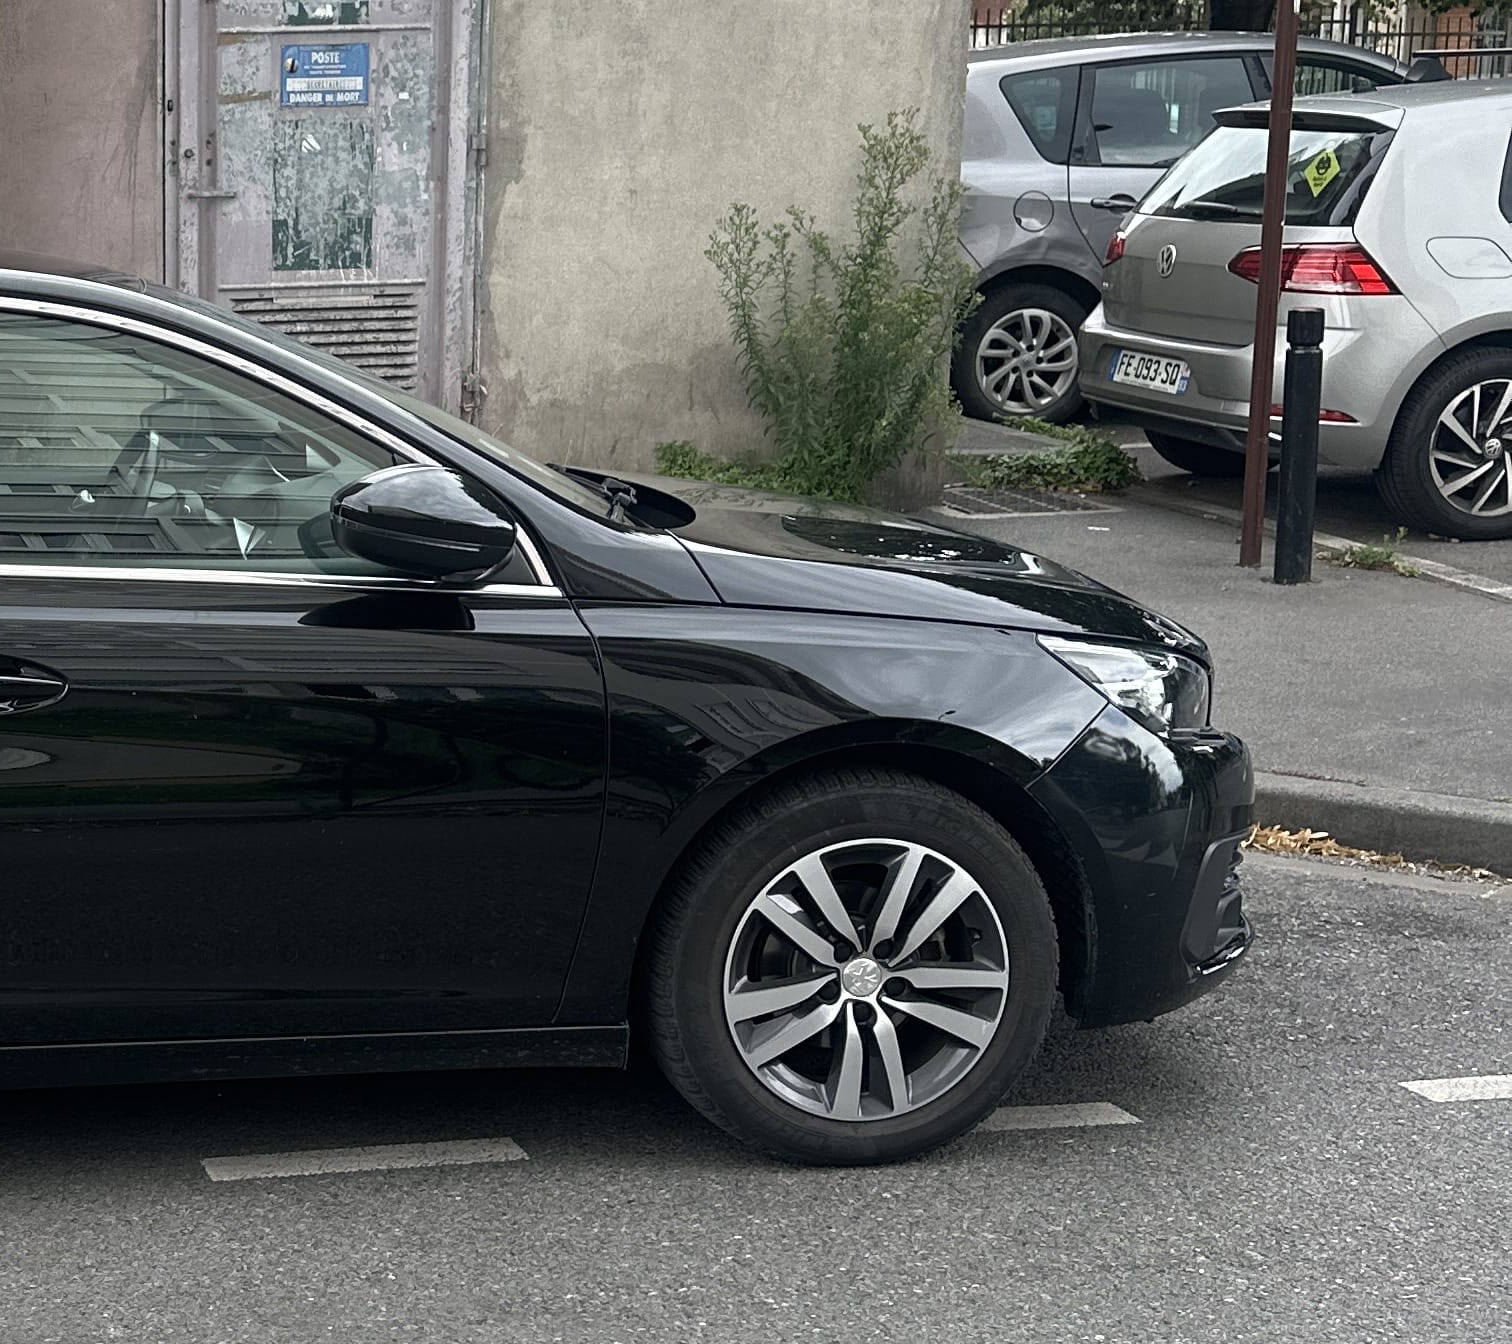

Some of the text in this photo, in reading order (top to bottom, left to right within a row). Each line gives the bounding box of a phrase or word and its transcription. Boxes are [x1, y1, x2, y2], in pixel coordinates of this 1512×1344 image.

[311, 51, 340, 64] POSTE
[289, 92, 323, 103] DANGER
[336, 91, 360, 102] MORT
[1117, 353, 1181, 386] FE-093-SQ
